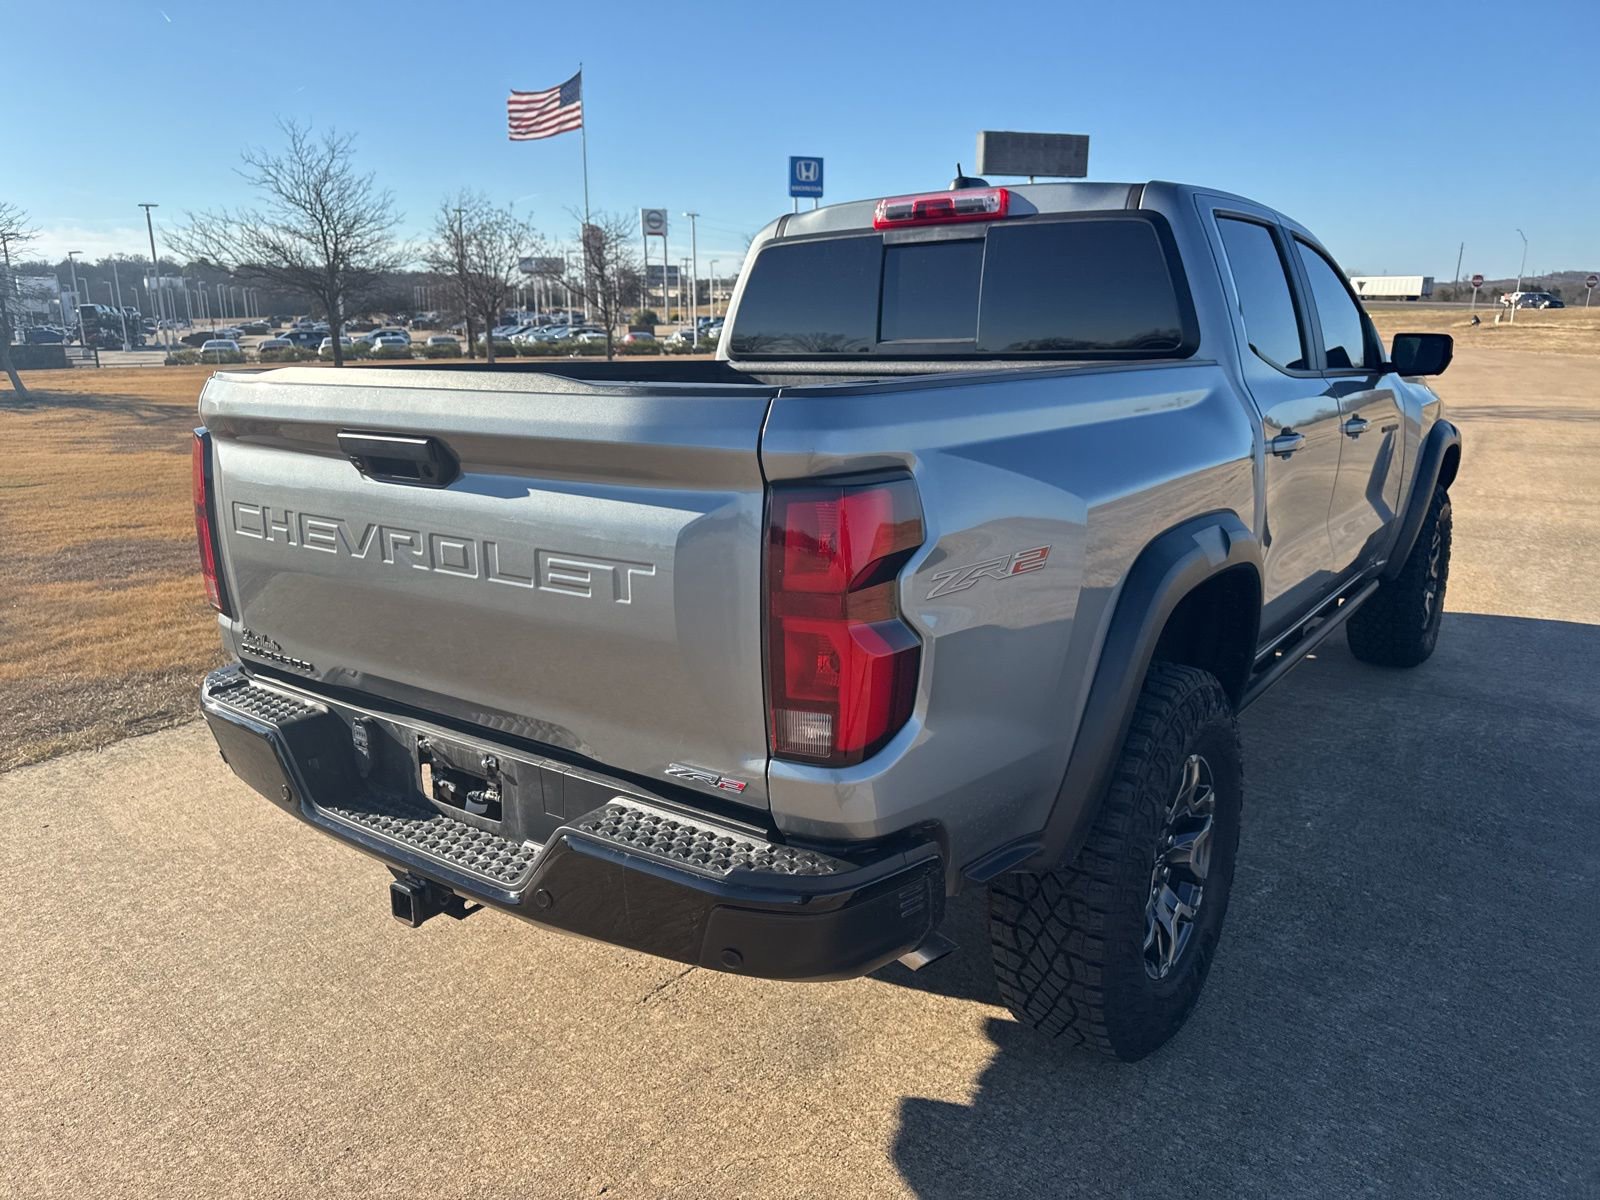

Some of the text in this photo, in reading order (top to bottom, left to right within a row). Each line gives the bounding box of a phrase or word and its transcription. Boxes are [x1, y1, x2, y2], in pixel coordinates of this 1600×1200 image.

[231, 501, 656, 605] CHEVROLET
[926, 544, 1052, 600] ZR2
[664, 762, 748, 794] ZR2
